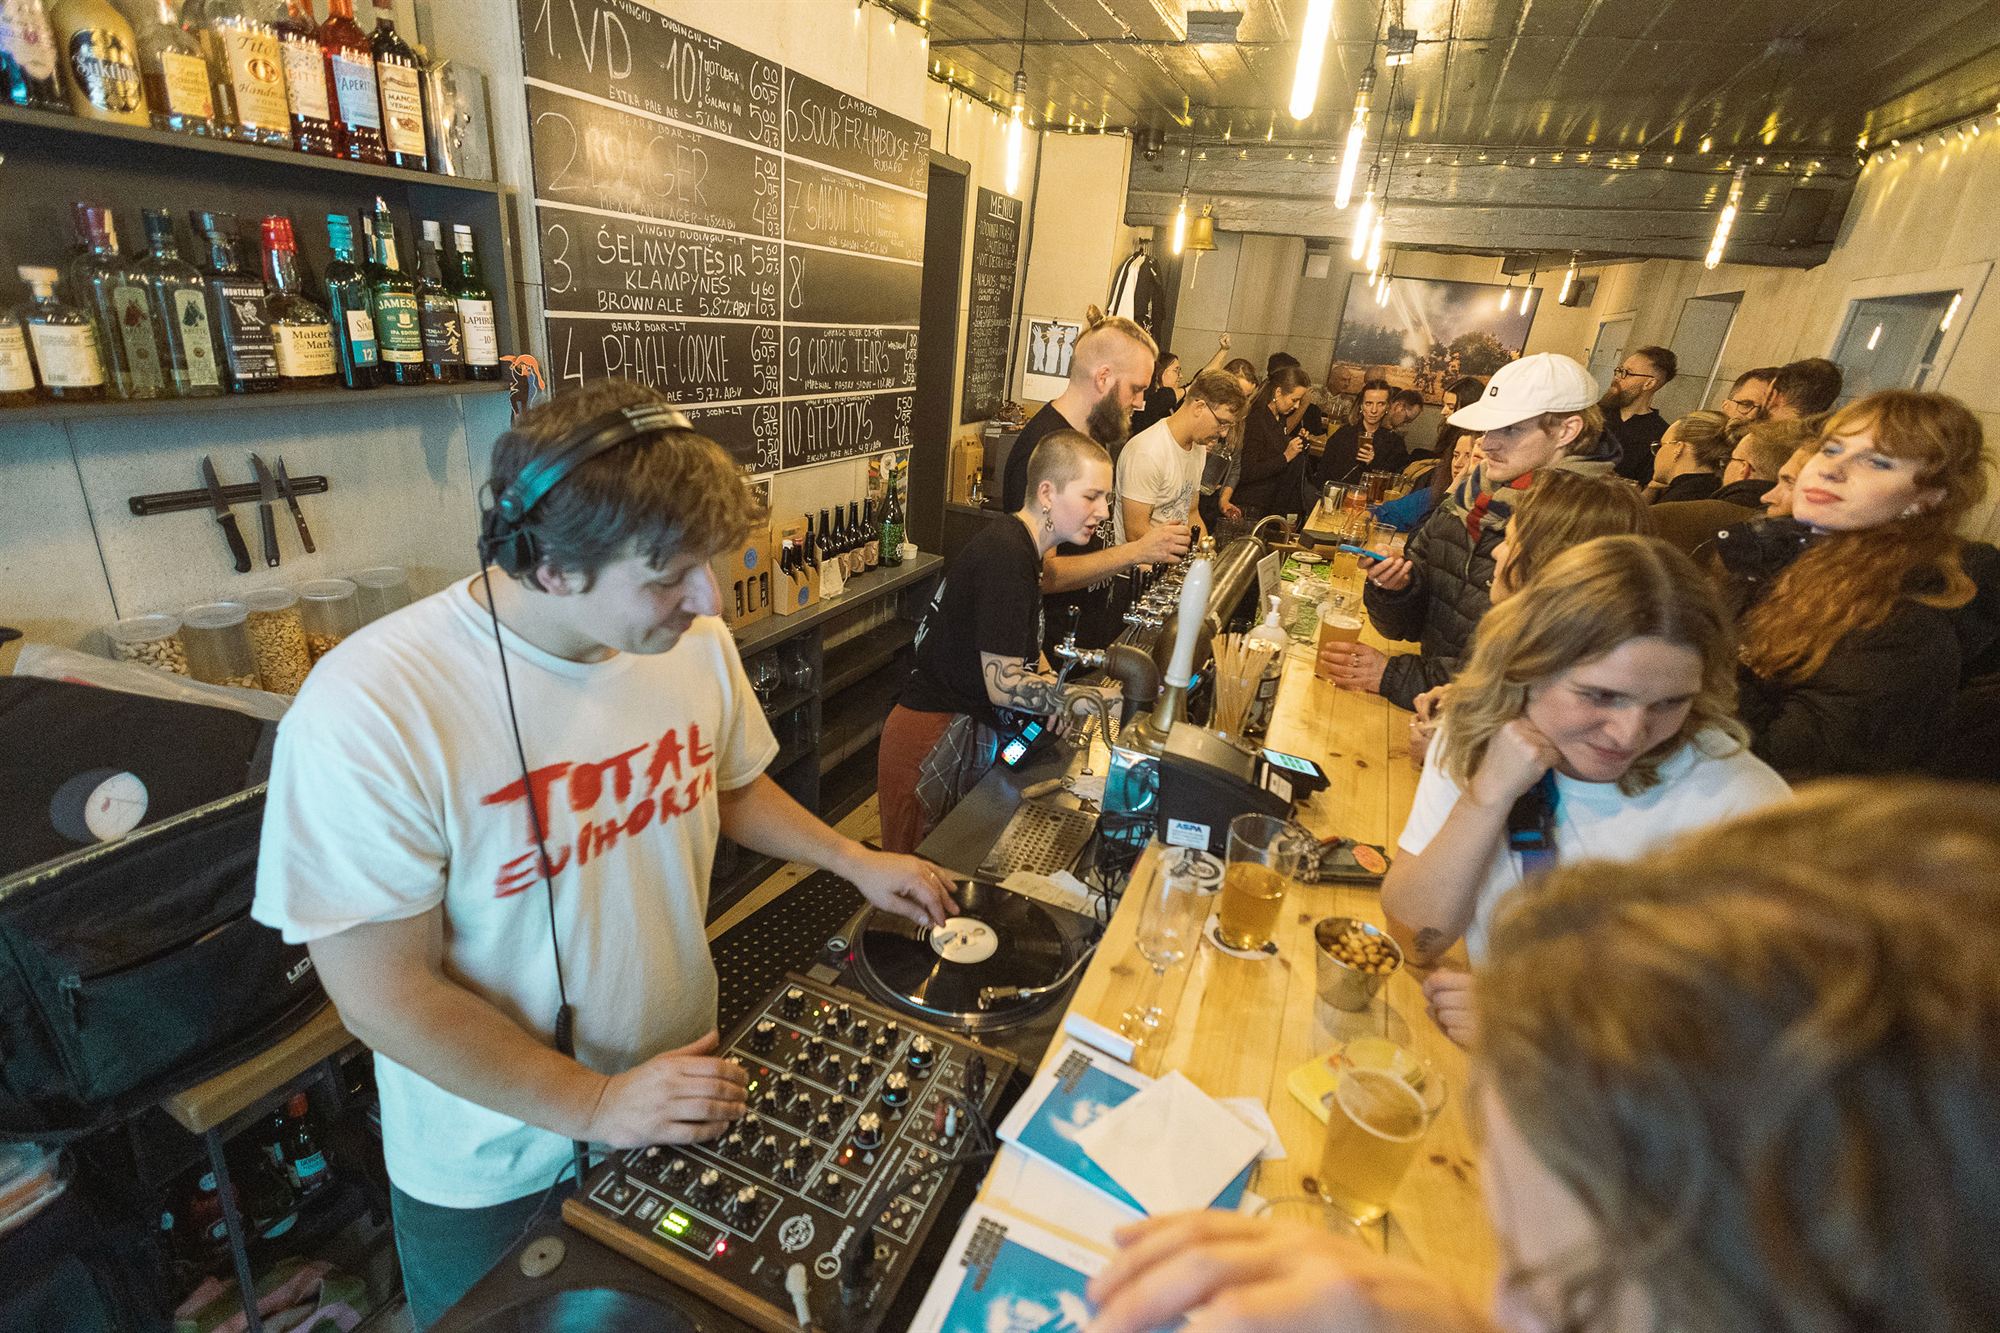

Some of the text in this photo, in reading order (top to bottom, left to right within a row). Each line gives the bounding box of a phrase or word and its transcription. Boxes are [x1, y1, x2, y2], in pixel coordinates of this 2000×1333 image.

[609, 85, 640, 107] EXTRA
[645, 99, 662, 114] PALE
[838, 95, 878, 119] CAMBIER
[379, 298, 418, 311] JAMESO
[597, 289, 654, 312] BROWN
[657, 298, 684, 313] ALE
[362, 348, 373, 361] 12
[666, 390, 683, 402] ALE
[480, 721, 715, 846] TOTAL
